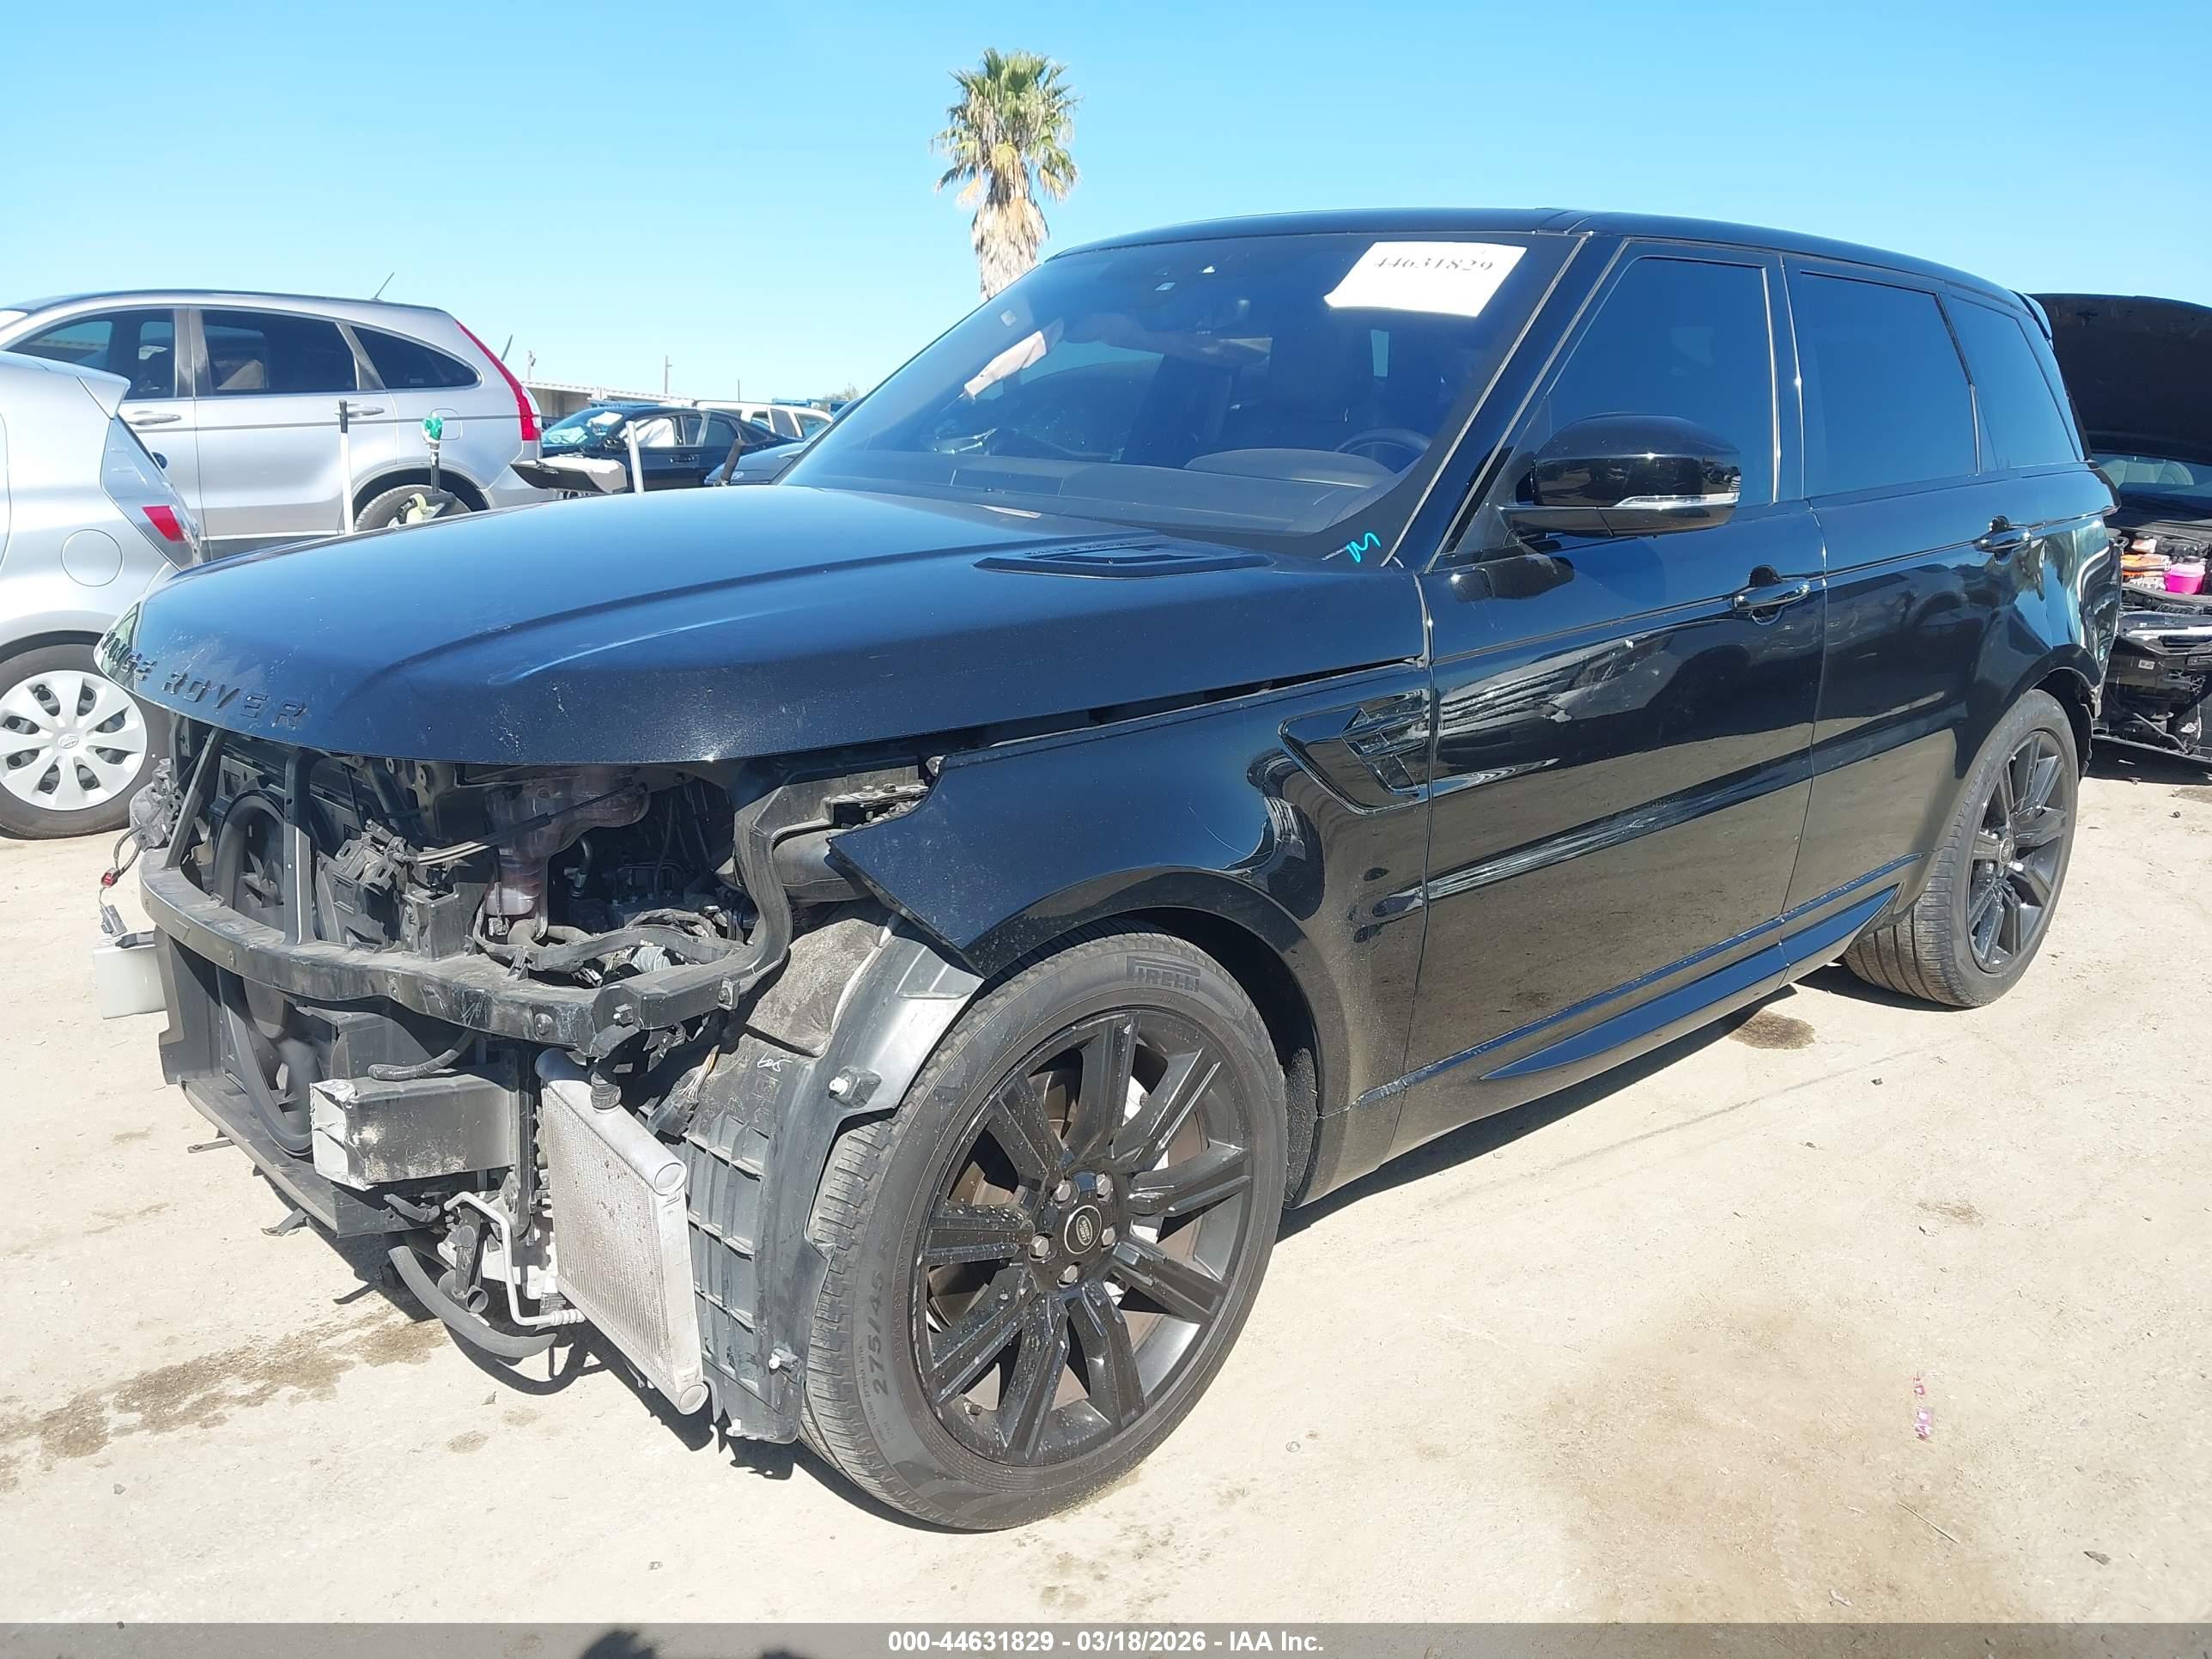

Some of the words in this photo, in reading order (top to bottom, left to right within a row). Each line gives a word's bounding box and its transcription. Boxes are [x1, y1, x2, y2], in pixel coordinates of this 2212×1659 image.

[1374, 256, 1493, 271] 44631829
[161, 672, 308, 730] ROVER
[1126, 954, 1200, 994] PIRELLI
